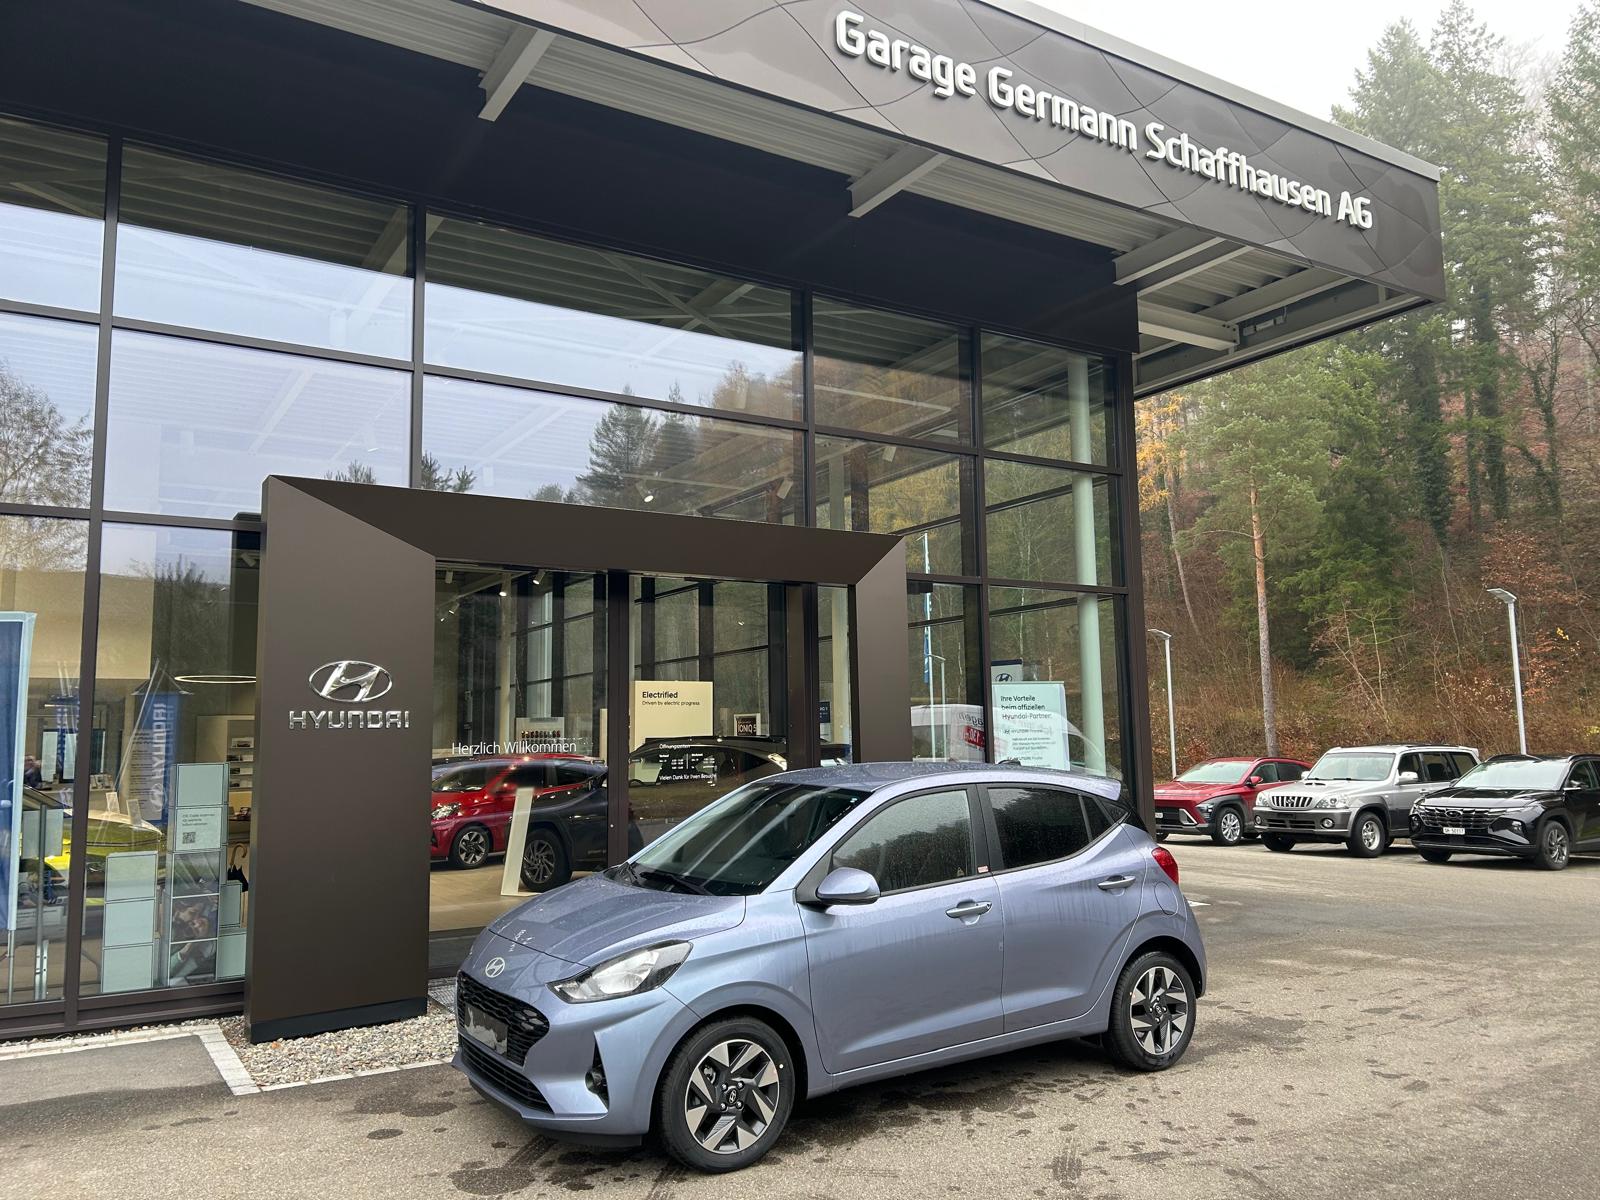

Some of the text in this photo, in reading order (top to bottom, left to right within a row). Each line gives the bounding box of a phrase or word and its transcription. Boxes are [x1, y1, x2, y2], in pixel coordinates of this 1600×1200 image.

[835, 10, 1373, 229] Garage Germann Schaffhausen AG
[642, 691, 678, 699] Electrified
[1012, 694, 1036, 702] Vorteile
[288, 710, 410, 729] HYUNDAI
[151, 703, 167, 780] HYUNDAI
[451, 739, 577, 755] Herzlich Willkommen
